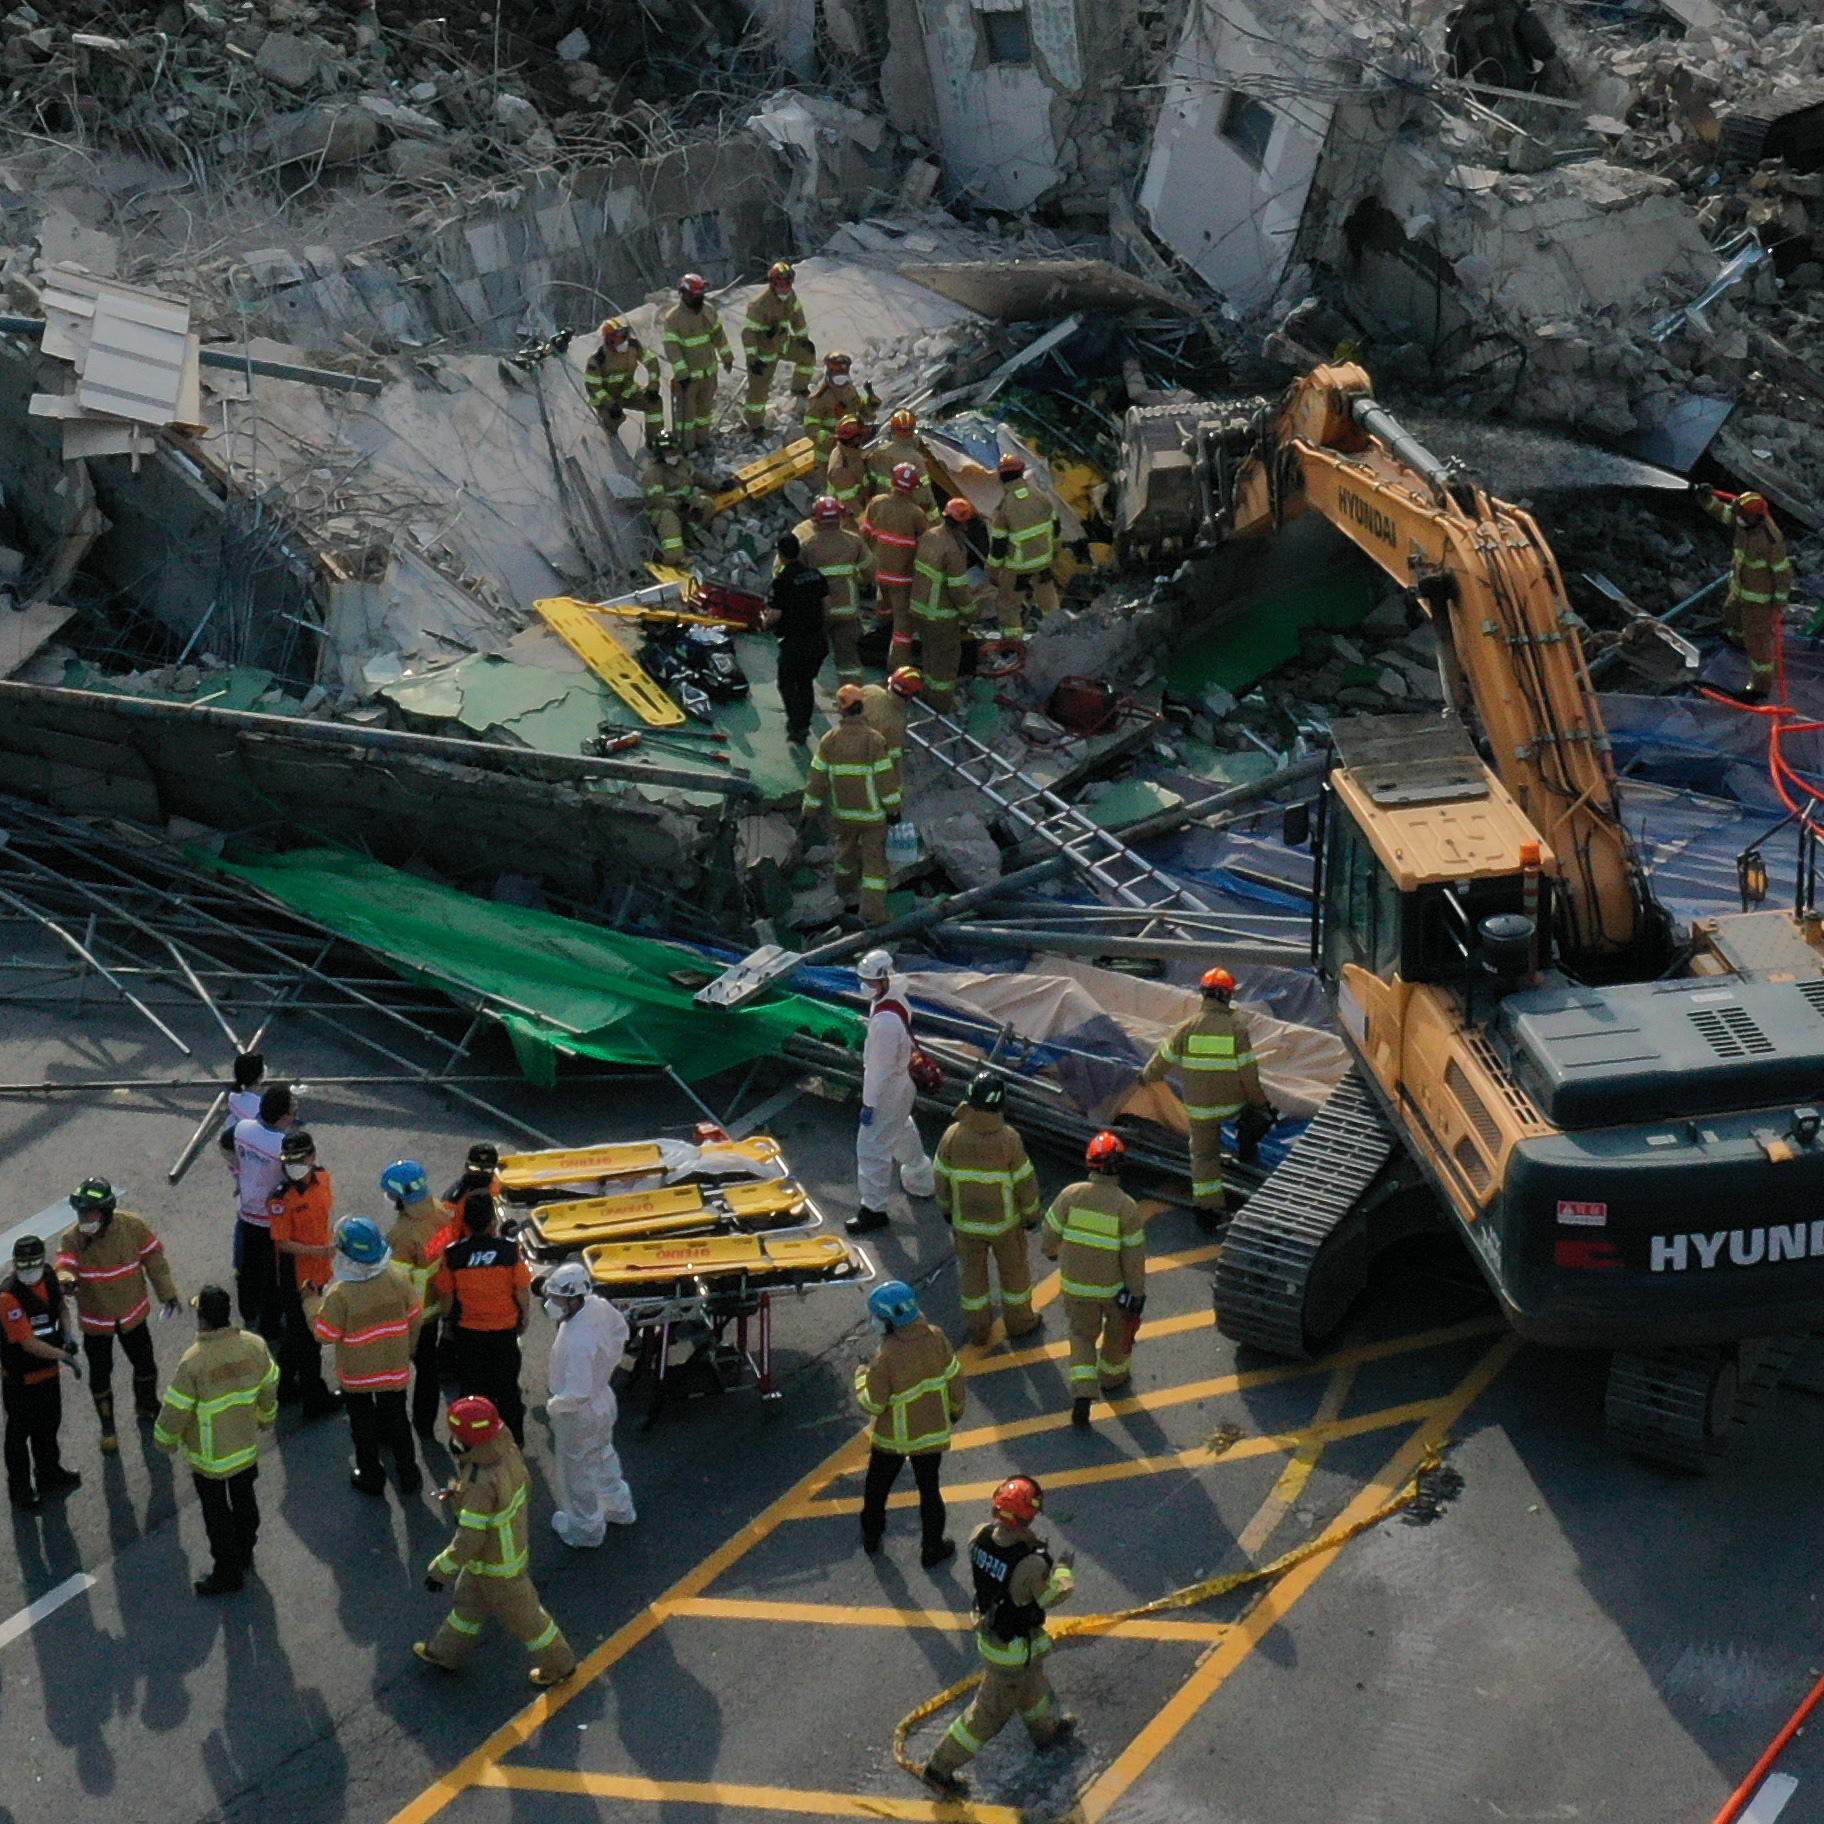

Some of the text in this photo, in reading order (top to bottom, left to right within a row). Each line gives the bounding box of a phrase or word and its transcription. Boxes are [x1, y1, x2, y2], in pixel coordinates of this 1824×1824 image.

[560, 1156, 601, 1169] FERNO
[600, 1203, 642, 1218] FERNO
[467, 1249, 498, 1266] 119
[655, 1249, 700, 1260] FERNO
